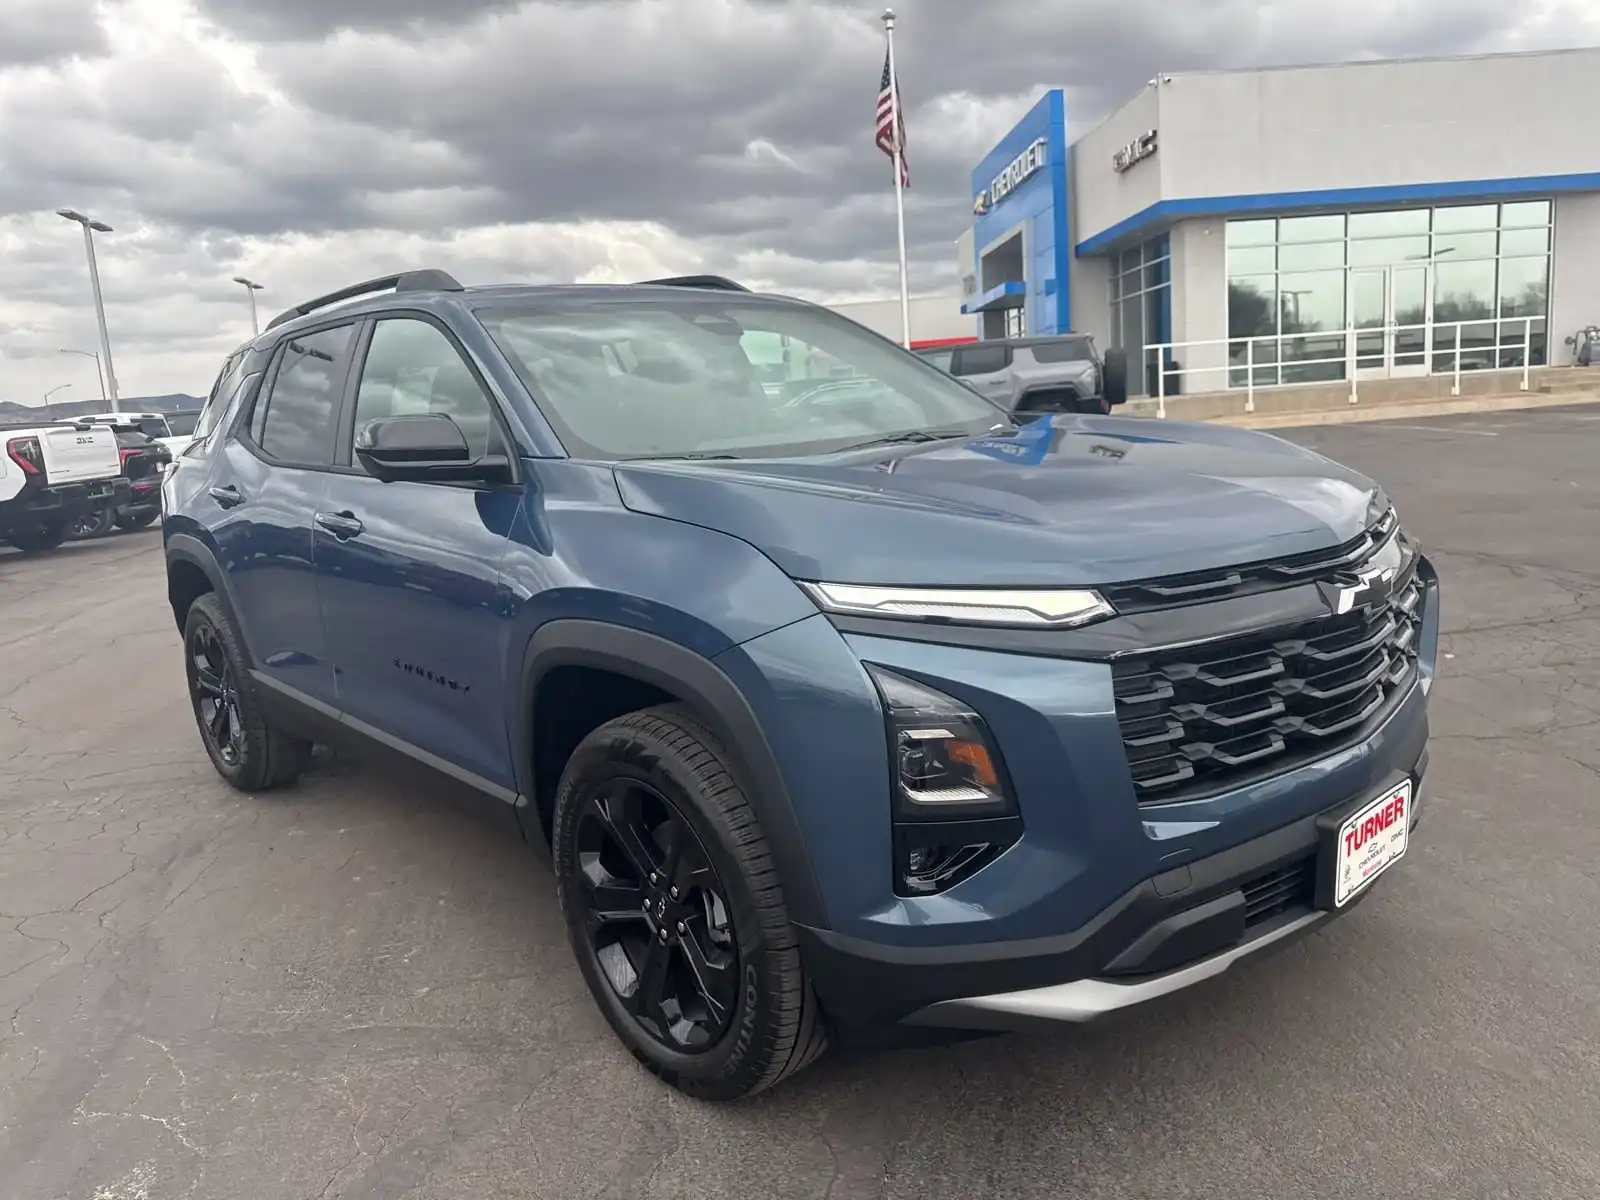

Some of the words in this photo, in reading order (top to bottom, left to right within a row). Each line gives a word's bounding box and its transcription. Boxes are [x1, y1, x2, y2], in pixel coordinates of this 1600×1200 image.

[991, 137, 1048, 204] CHEVROLET
[1113, 129, 1158, 174] GMC
[1345, 796, 1405, 857] TURNER
